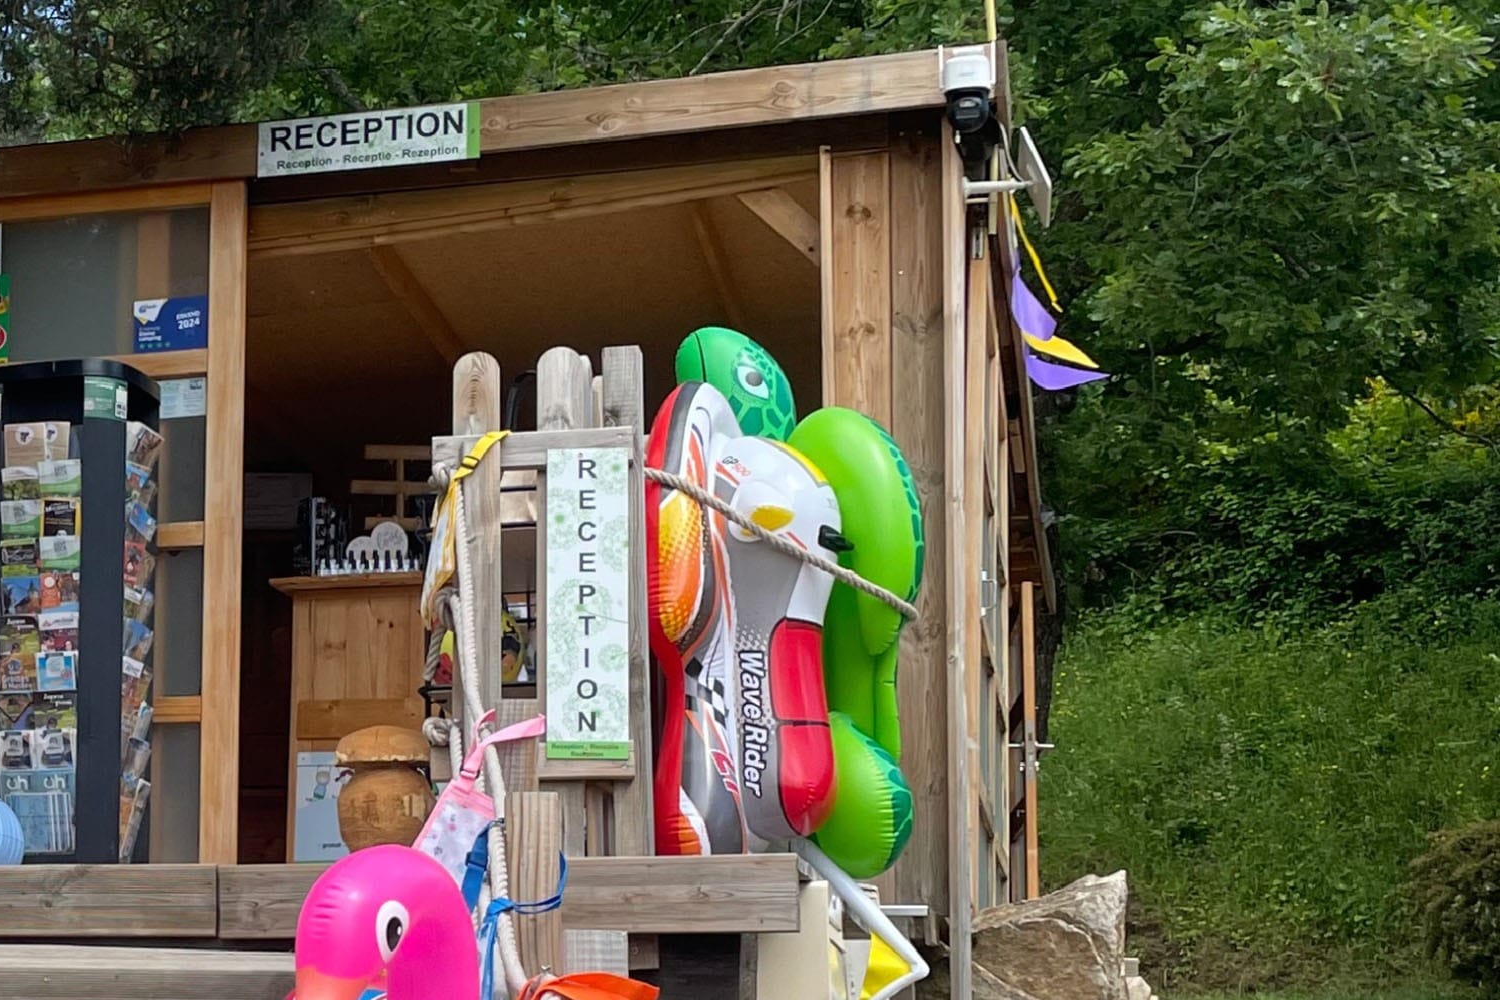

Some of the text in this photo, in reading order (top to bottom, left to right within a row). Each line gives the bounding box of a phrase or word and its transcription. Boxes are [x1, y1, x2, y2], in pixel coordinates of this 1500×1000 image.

[269, 109, 464, 152] RECEPTION
[276, 155, 333, 170] Reception
[343, 152, 392, 165] Receptie
[402, 145, 459, 159] Rezeption
[177, 317, 201, 330] 2024
[577, 459, 598, 732] RECEPTION
[738, 650, 770, 799] Wave Rider
